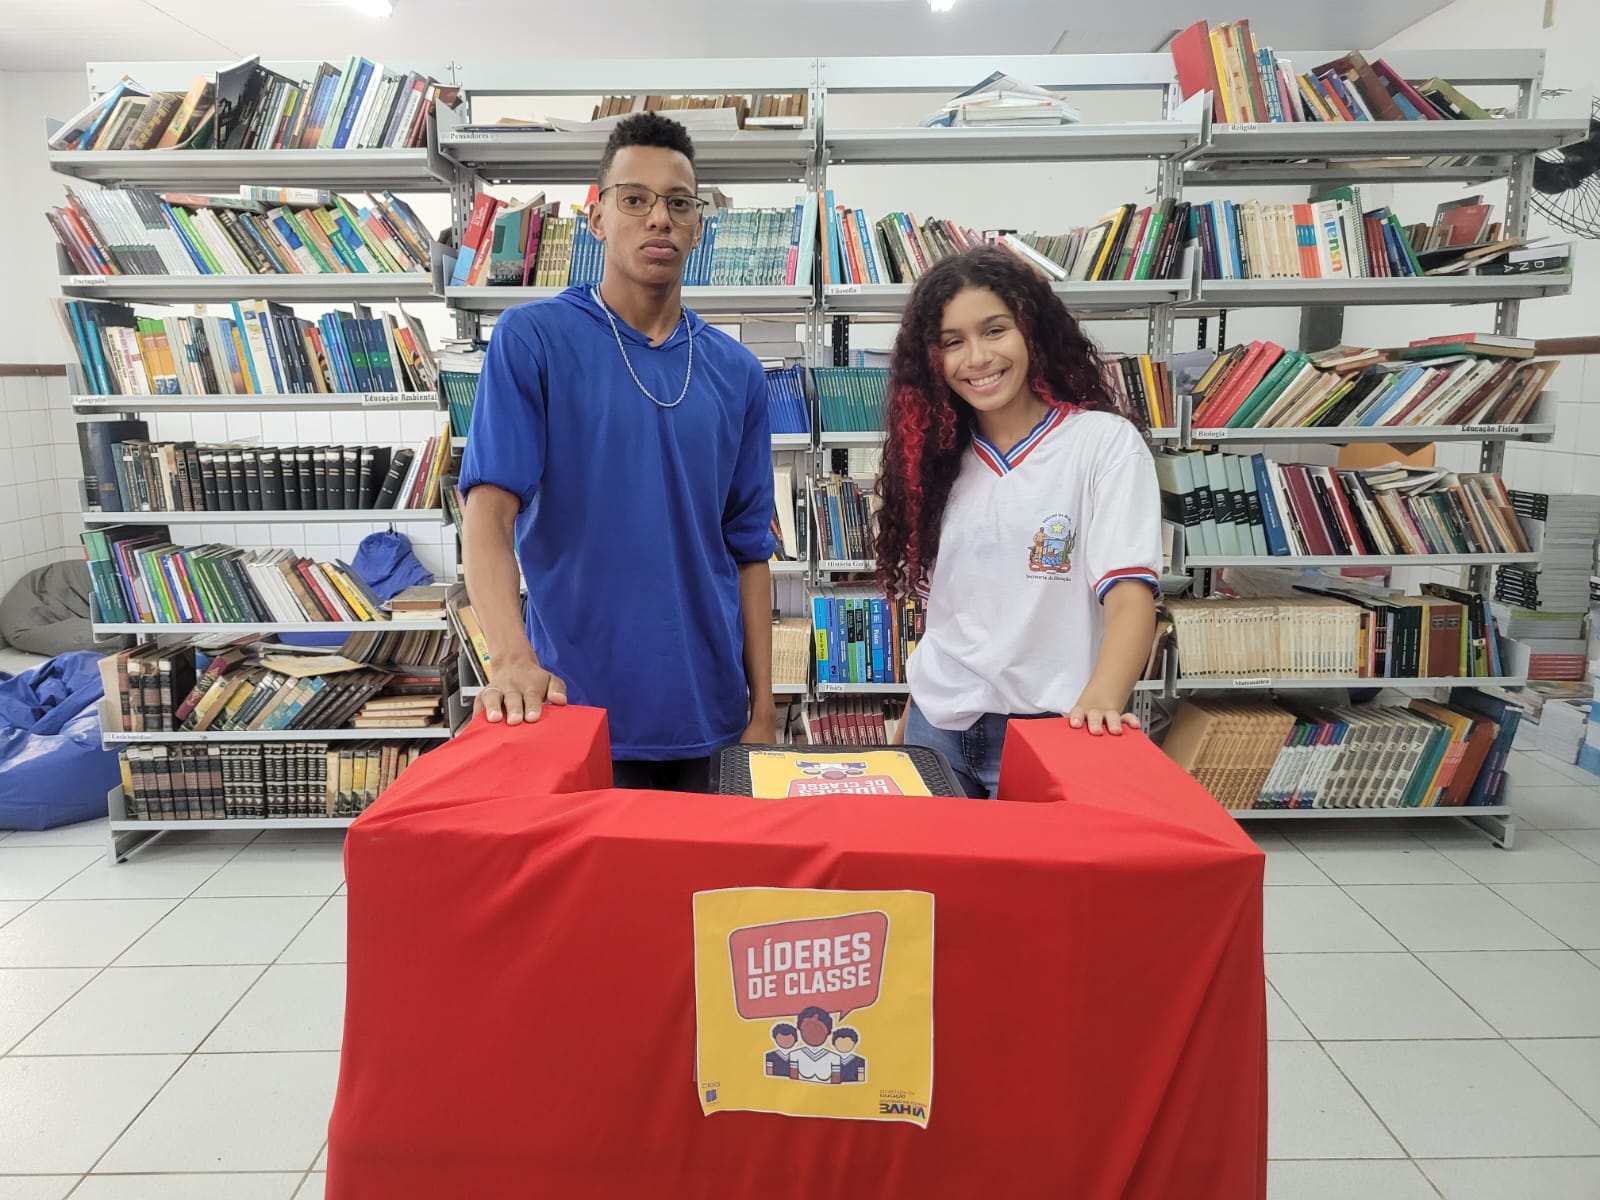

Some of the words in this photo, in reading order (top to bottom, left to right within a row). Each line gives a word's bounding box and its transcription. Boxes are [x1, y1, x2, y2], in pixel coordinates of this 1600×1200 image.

[73, 278, 105, 286] Português
[364, 393, 399, 403] Educação
[400, 393, 437, 402] Ambiental
[1461, 423, 1495, 433] Educação
[1497, 424, 1519, 432] Física
[1198, 430, 1225, 438] Biologia
[1234, 679, 1270, 687] Matemática
[747, 932, 871, 976] LÍDERES
[748, 975, 777, 1000] DE
[784, 963, 871, 996] CLASSE
[879, 1103, 926, 1120] BAHIA
